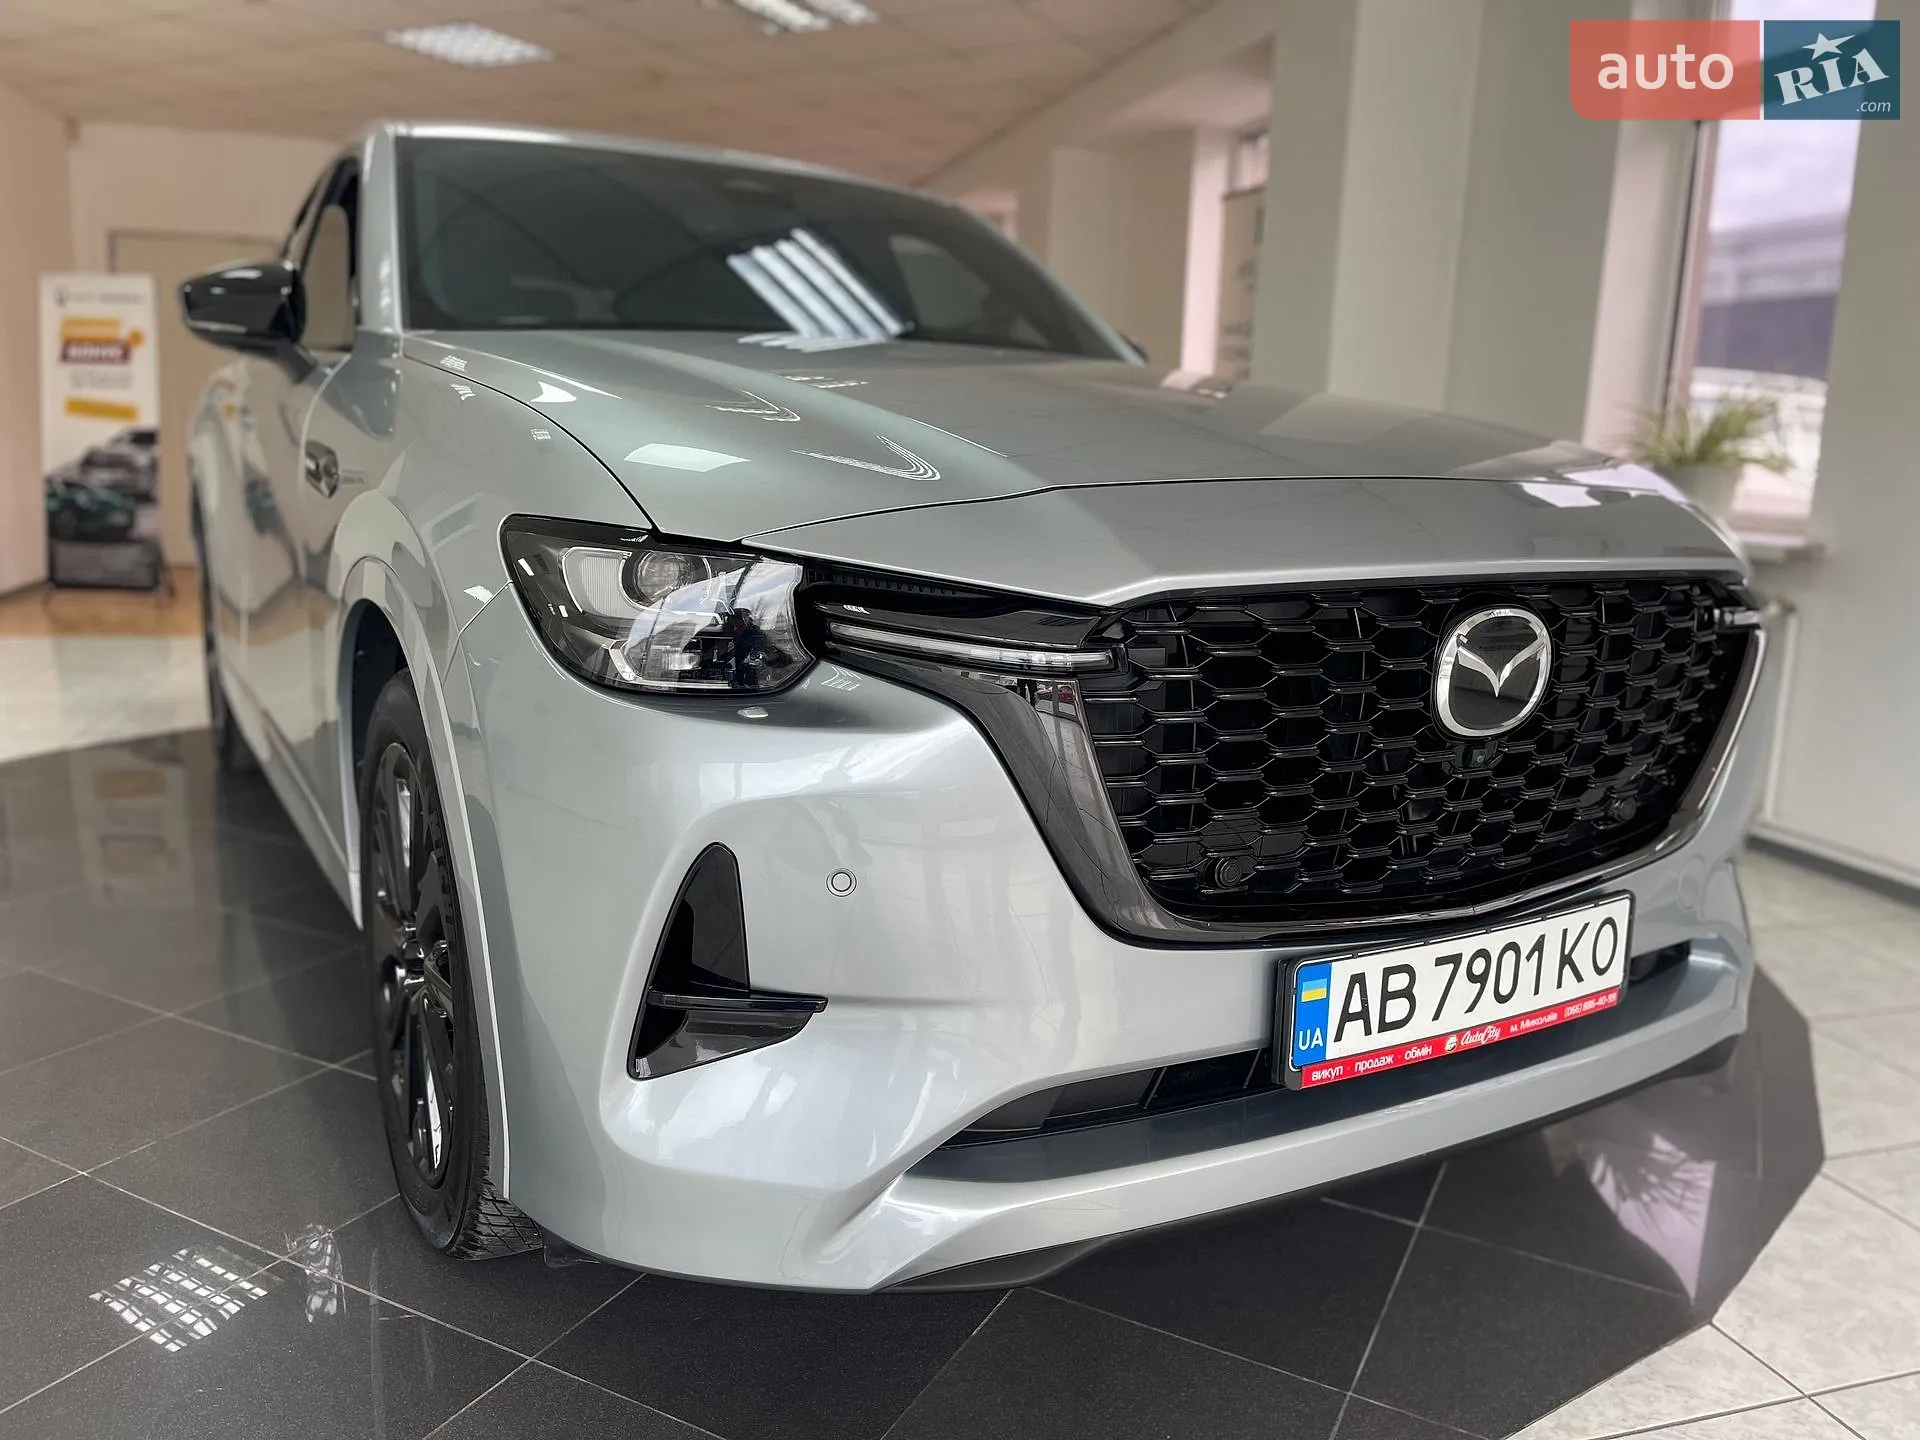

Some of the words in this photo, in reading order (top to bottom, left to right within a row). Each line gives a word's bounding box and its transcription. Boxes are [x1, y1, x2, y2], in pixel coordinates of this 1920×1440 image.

[1333, 963, 1418, 1043] AB
[1432, 933, 1546, 1022] 7901
[1556, 916, 1618, 990] KO
[1299, 1027, 1324, 1051] UA
[1311, 1065, 1344, 1082] викуп
[1354, 1054, 1395, 1073] продаж
[1404, 1044, 1433, 1061] обмін
